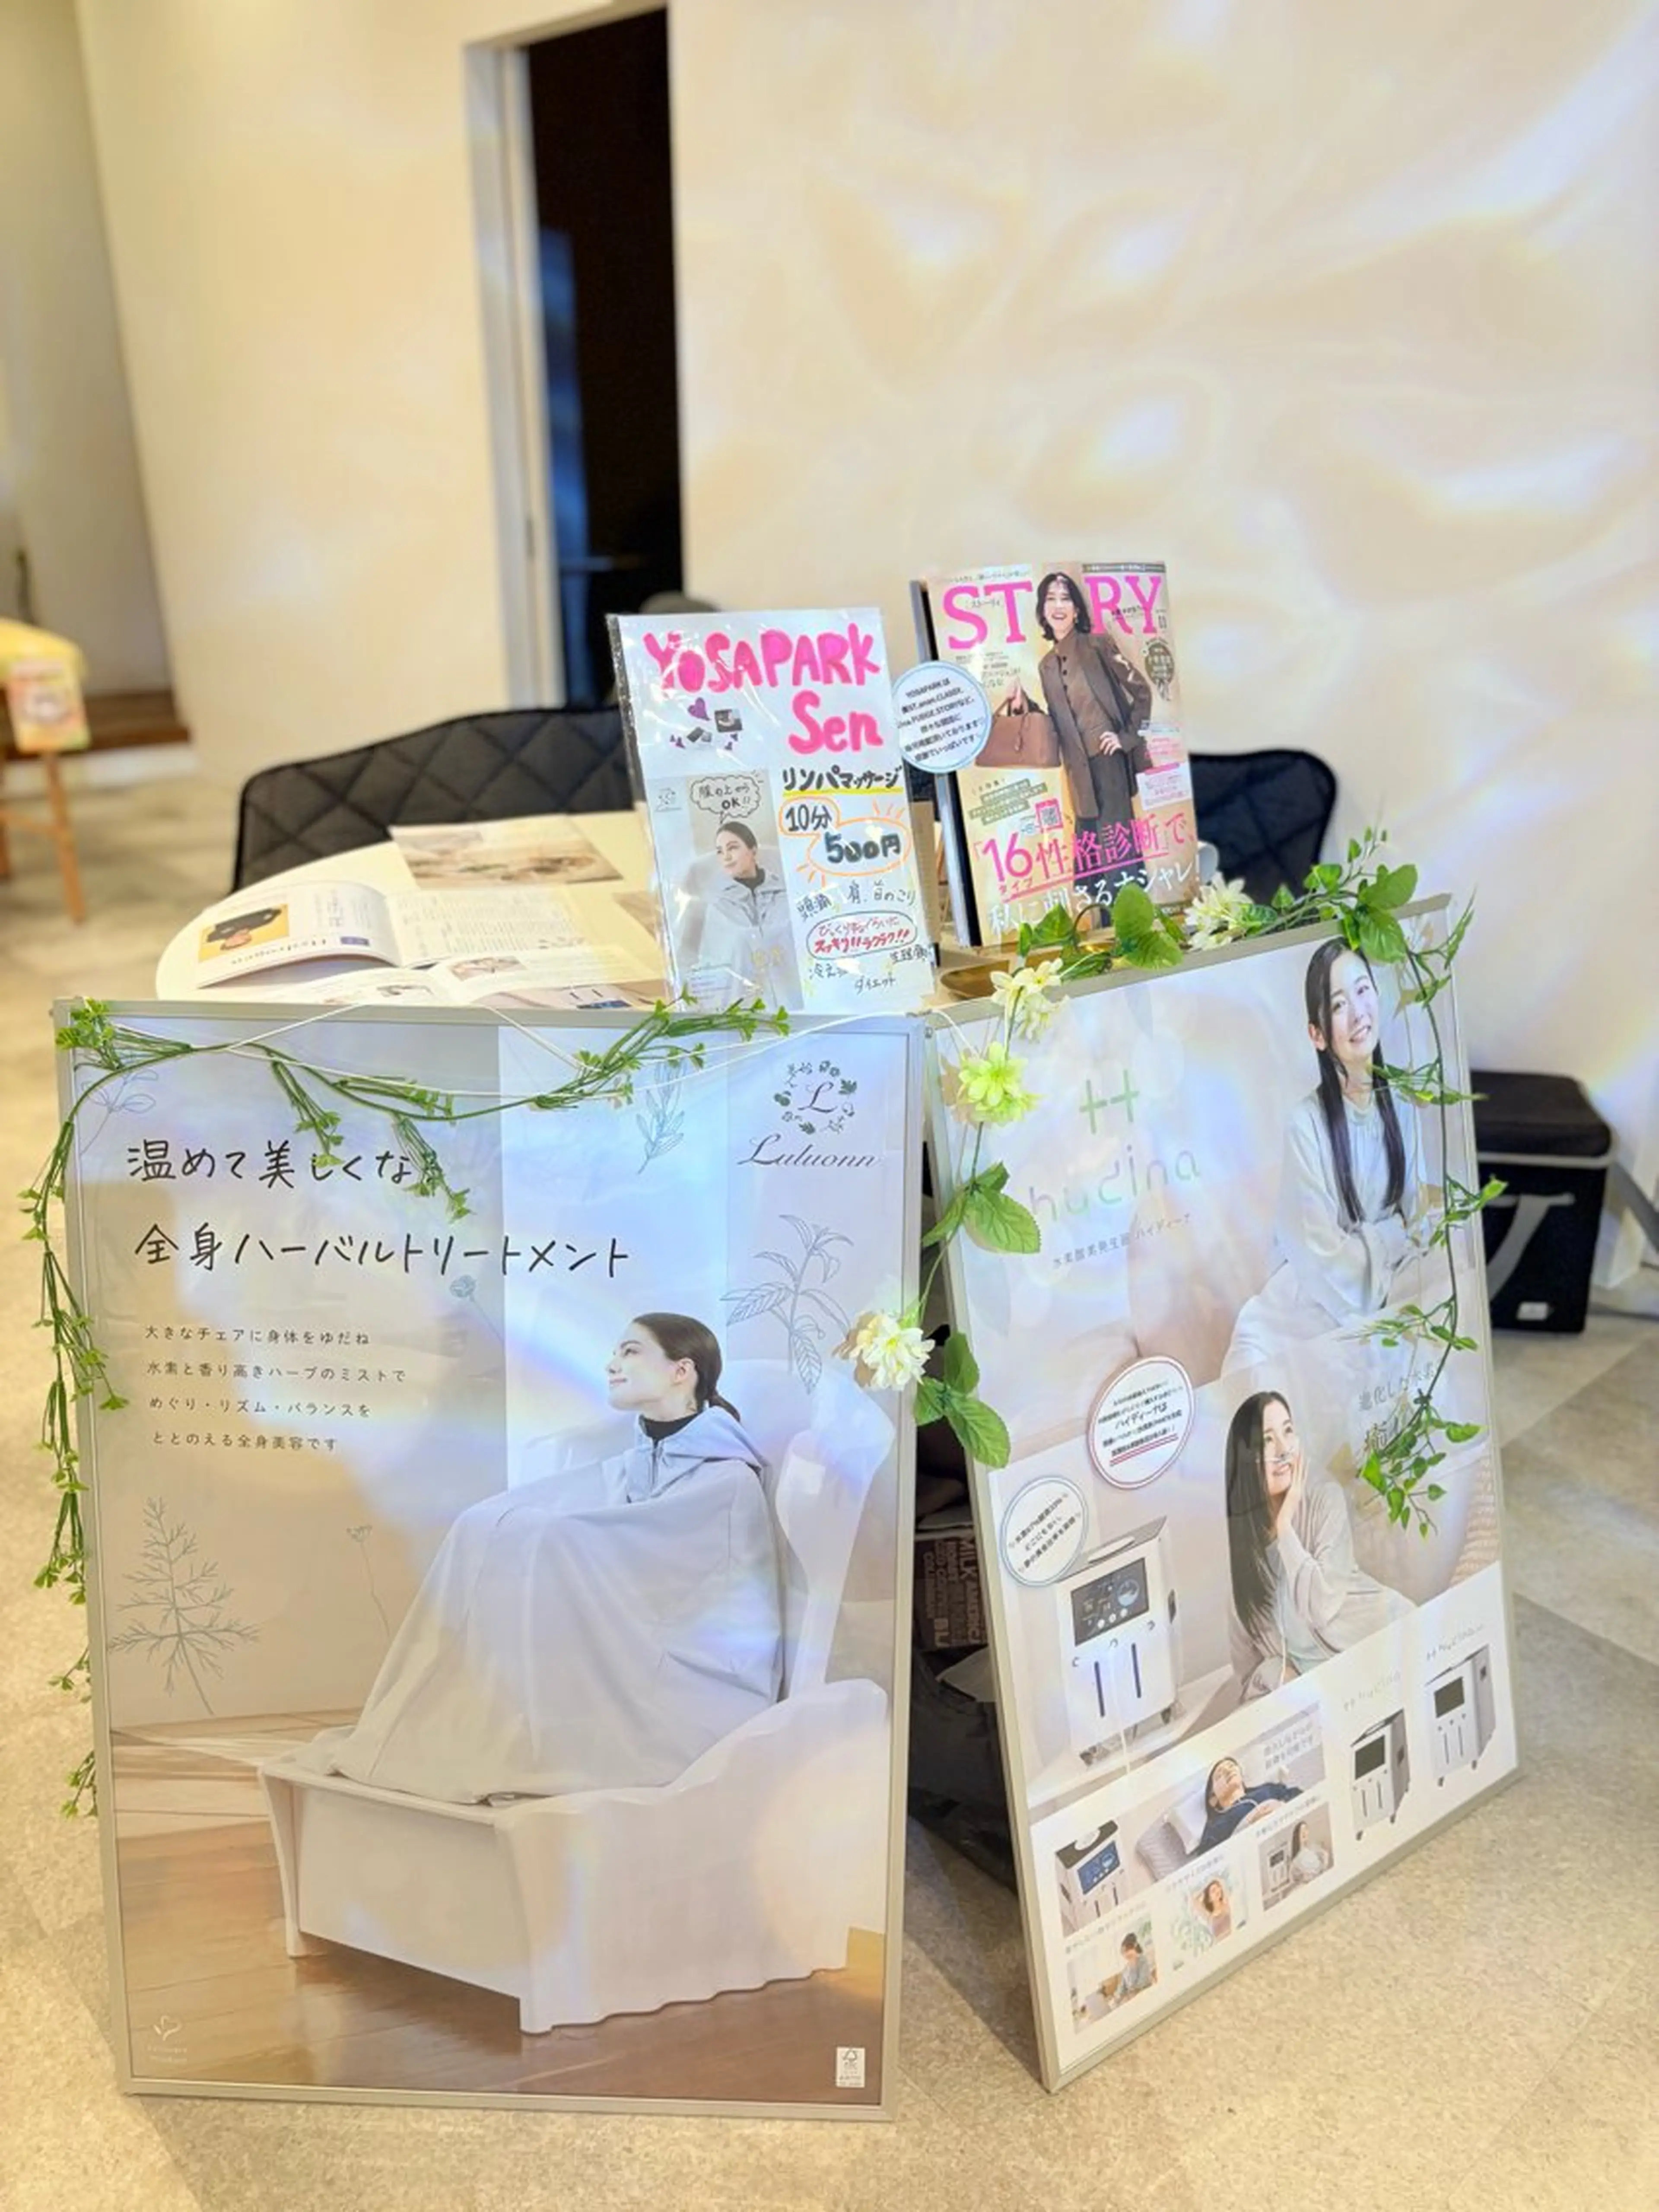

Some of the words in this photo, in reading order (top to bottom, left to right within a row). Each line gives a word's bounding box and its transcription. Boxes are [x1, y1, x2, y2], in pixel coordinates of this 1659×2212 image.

[943, 575, 1162, 650] STRY
[642, 623, 881, 694] YOSAPARK
[788, 690, 884, 755] Sen
[782, 764, 903, 791] リンパマッサージ
[785, 804, 833, 832] 10分
[824, 831, 901, 863] 500円
[127, 1138, 414, 1189] 温めて美しくな
[134, 1222, 629, 1278] 全身ハーバルトリートメント
[144, 1325, 370, 1345] 大きなチェアに身体をゆだね
[149, 1397, 371, 1417] めぐり・リズム・バランスを
[153, 1431, 338, 1451] ととのえる全身美容です
